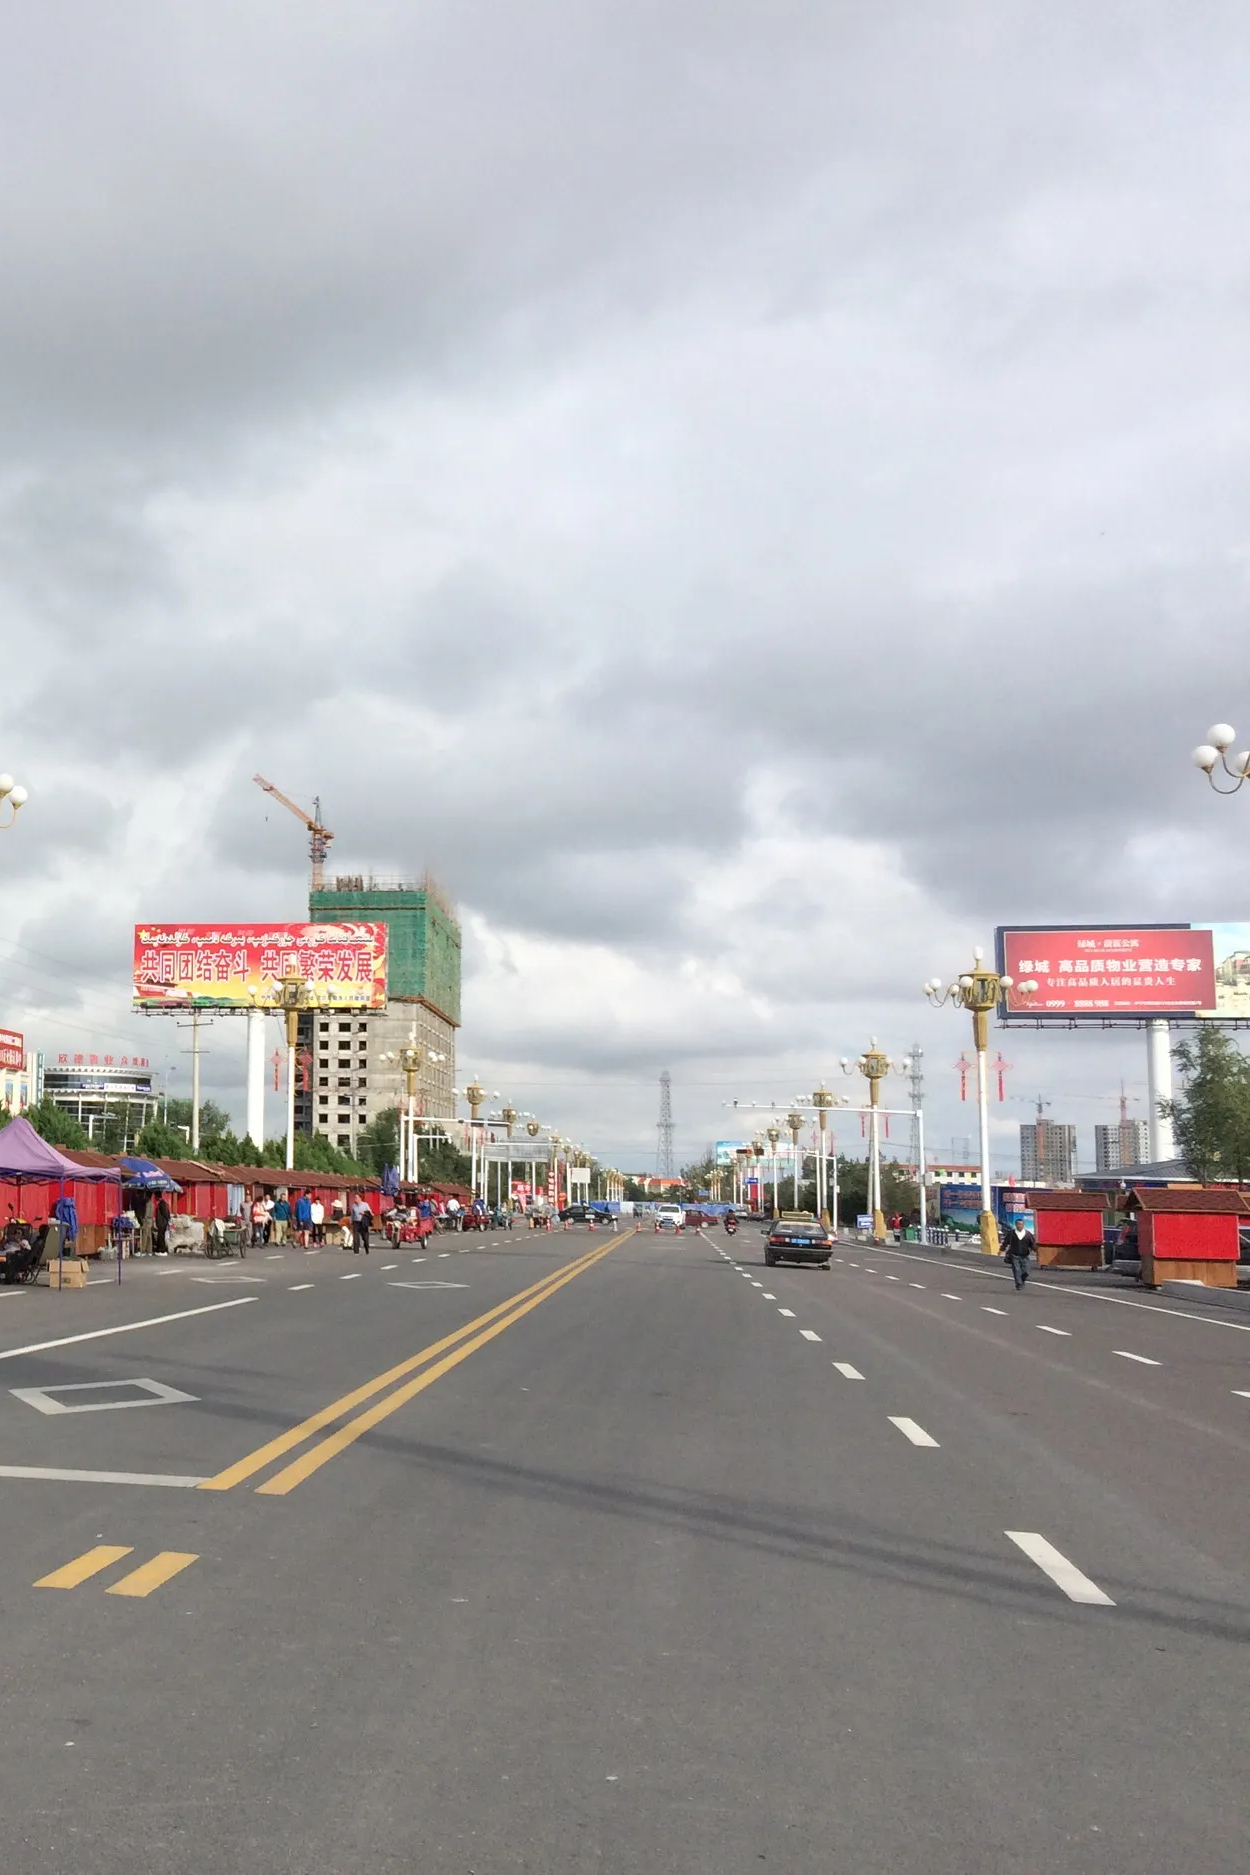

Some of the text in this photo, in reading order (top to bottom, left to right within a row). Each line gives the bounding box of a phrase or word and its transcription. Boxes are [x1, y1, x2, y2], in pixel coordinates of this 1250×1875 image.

[141, 949, 374, 983] 共同团结奋斗 共同繁荣发展
[1018, 958, 1202, 973] 绿城 高品质物业营造专家
